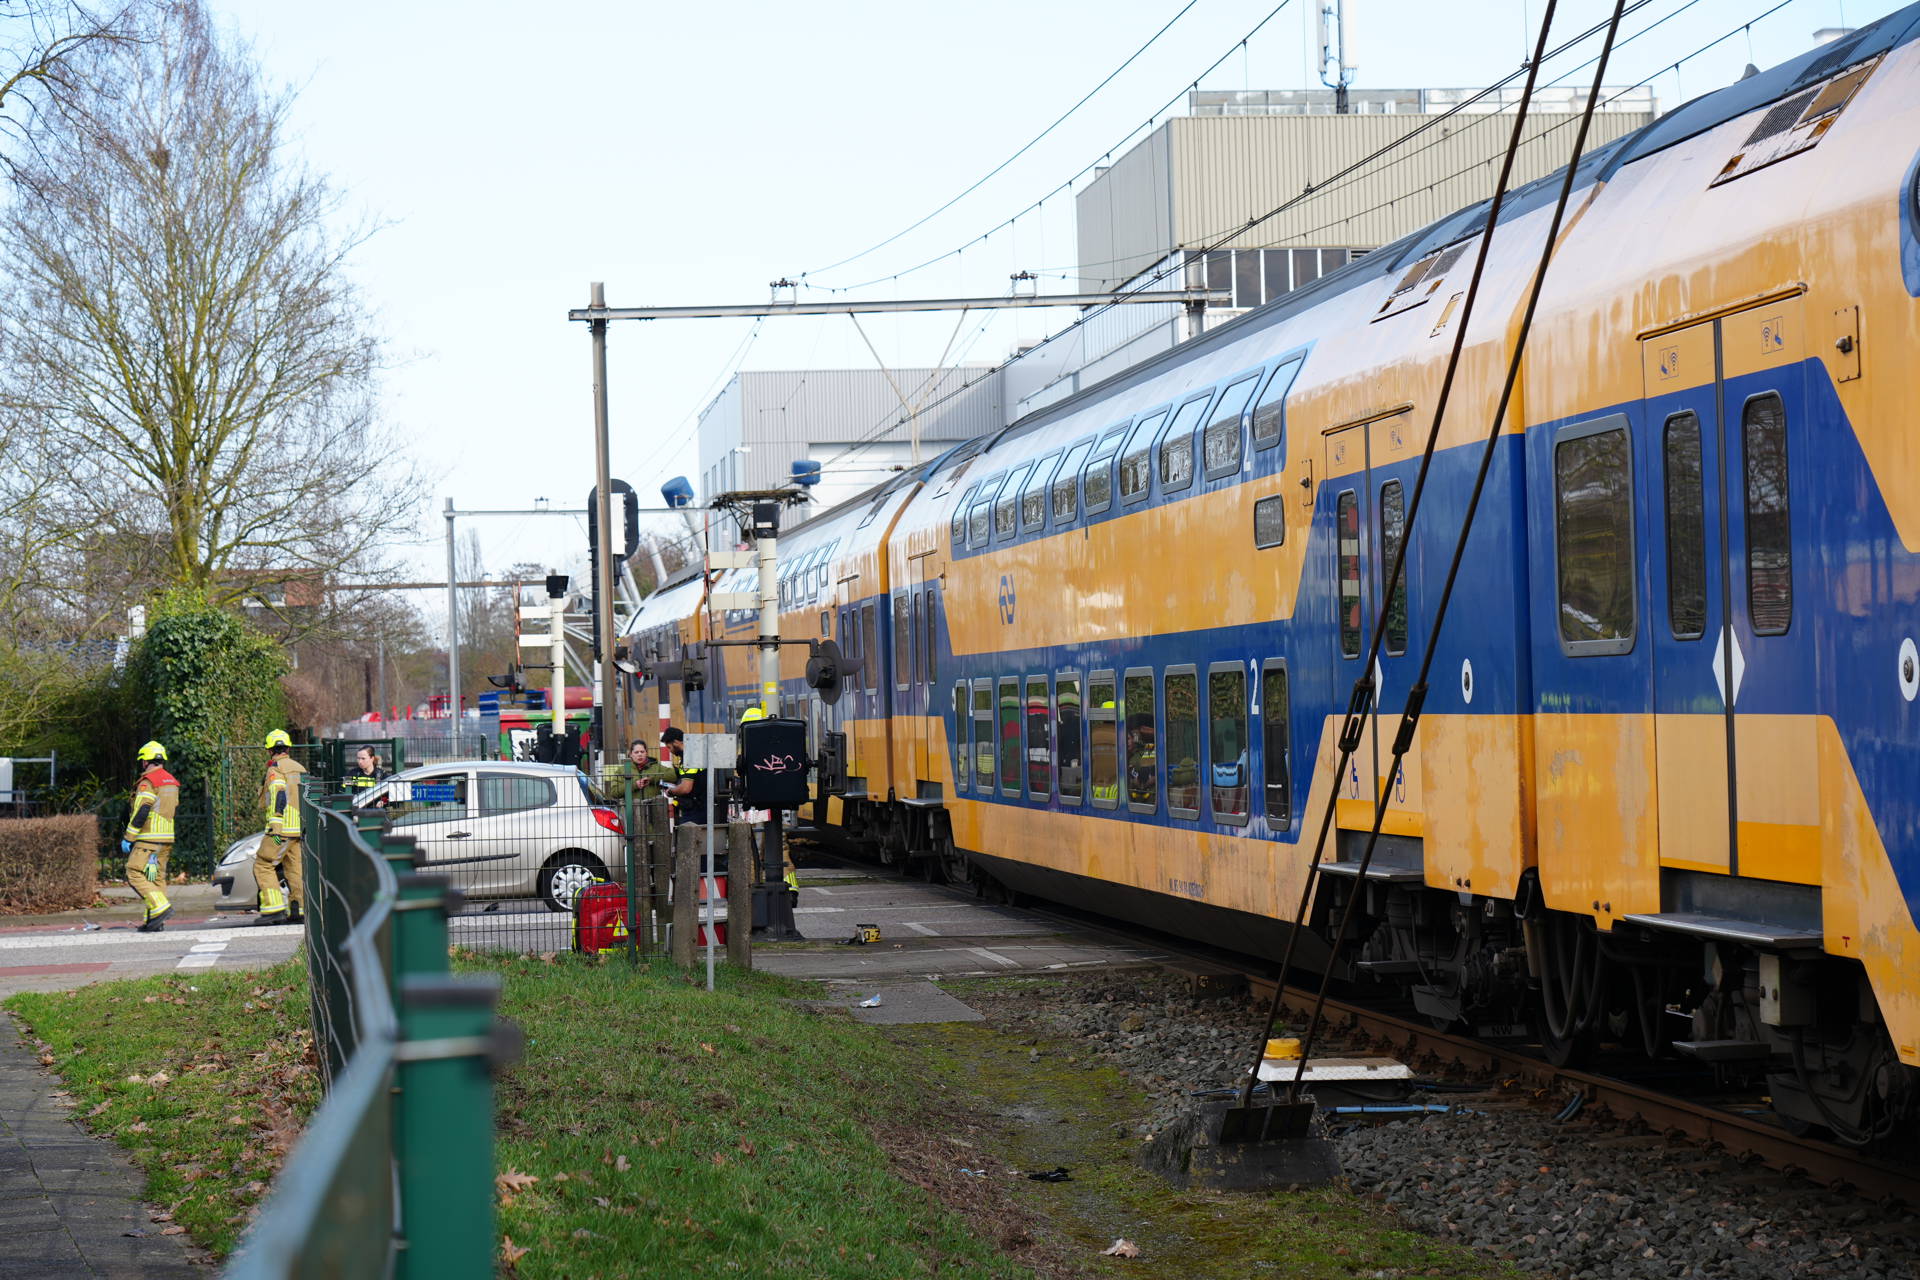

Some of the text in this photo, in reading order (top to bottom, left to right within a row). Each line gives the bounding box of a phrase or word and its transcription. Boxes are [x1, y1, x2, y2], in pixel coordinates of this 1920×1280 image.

[1242, 415, 1251, 472] 2
[968, 677, 973, 717] 2
[1250, 658, 1260, 715] 2
